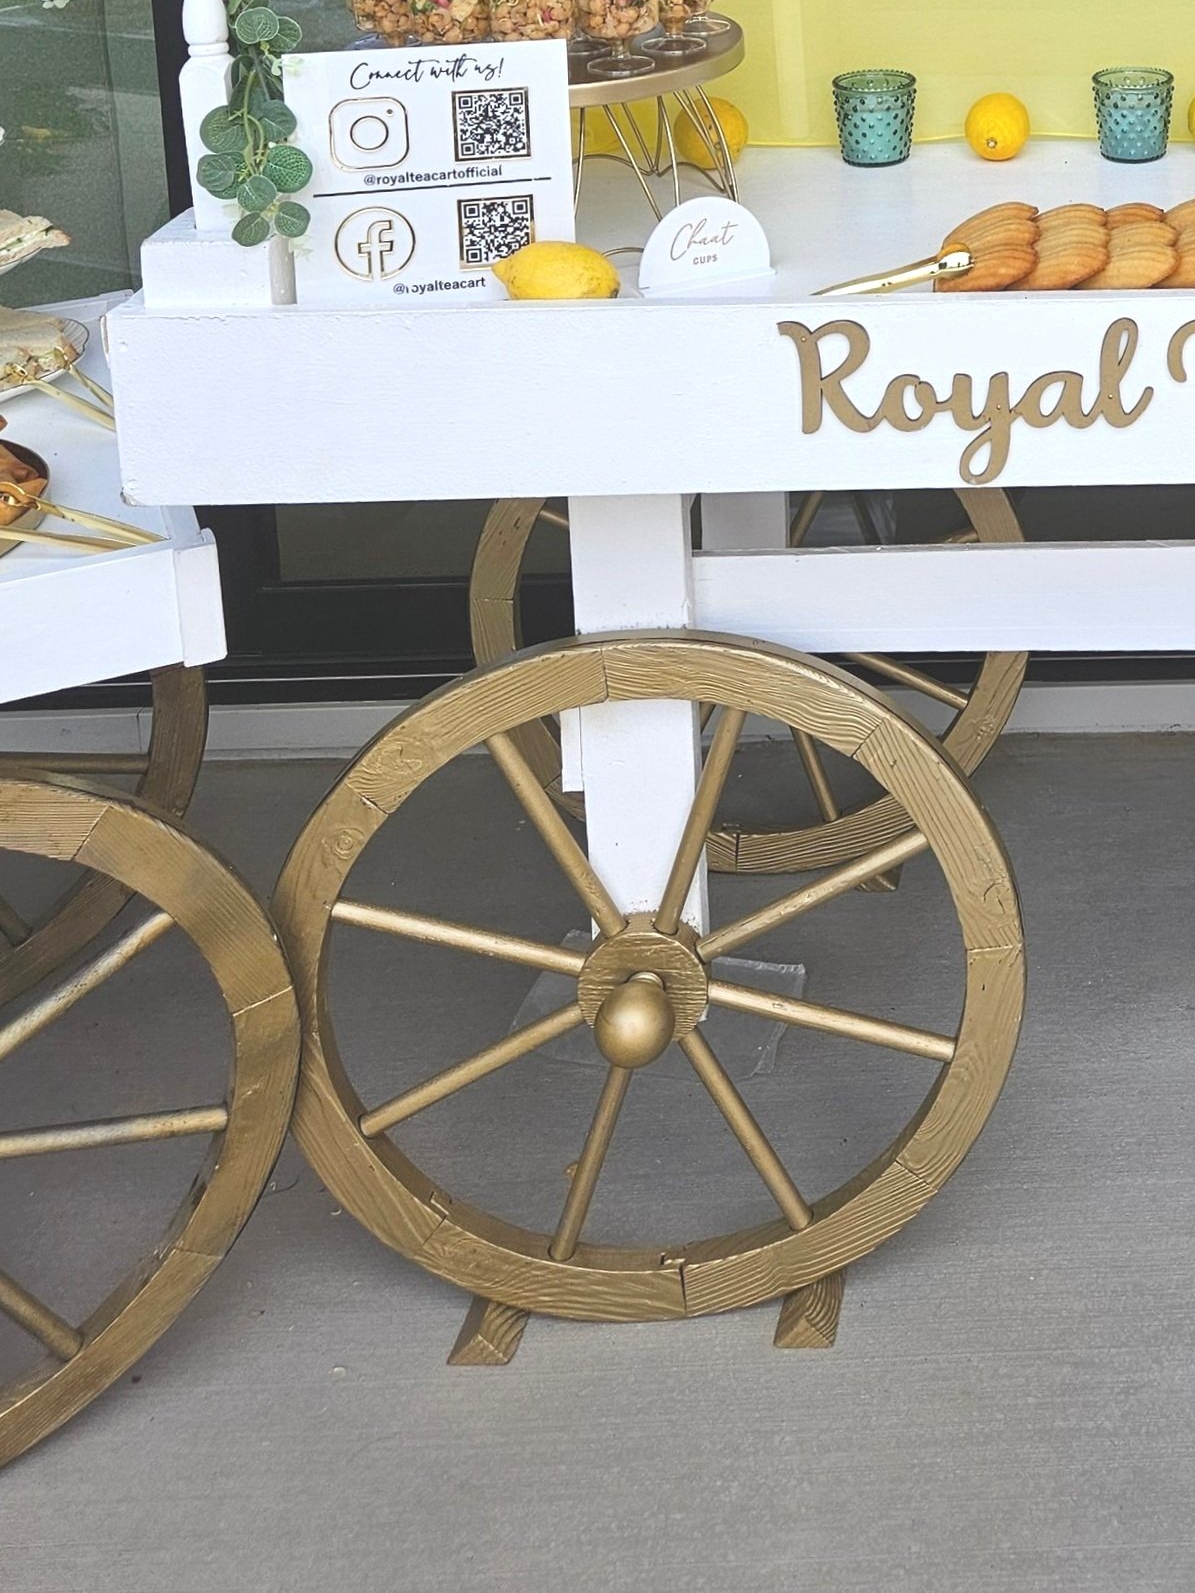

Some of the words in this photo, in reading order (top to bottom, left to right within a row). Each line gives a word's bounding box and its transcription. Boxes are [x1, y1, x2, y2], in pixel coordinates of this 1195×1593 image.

[350, 59, 438, 90] Connect
[430, 53, 477, 82] with
[474, 57, 504, 81] us!
[363, 165, 503, 186] @royalteacartofficial
[670, 218, 739, 261] Chaat
[692, 254, 718, 266] CUPS
[777, 317, 1153, 486] Royal
